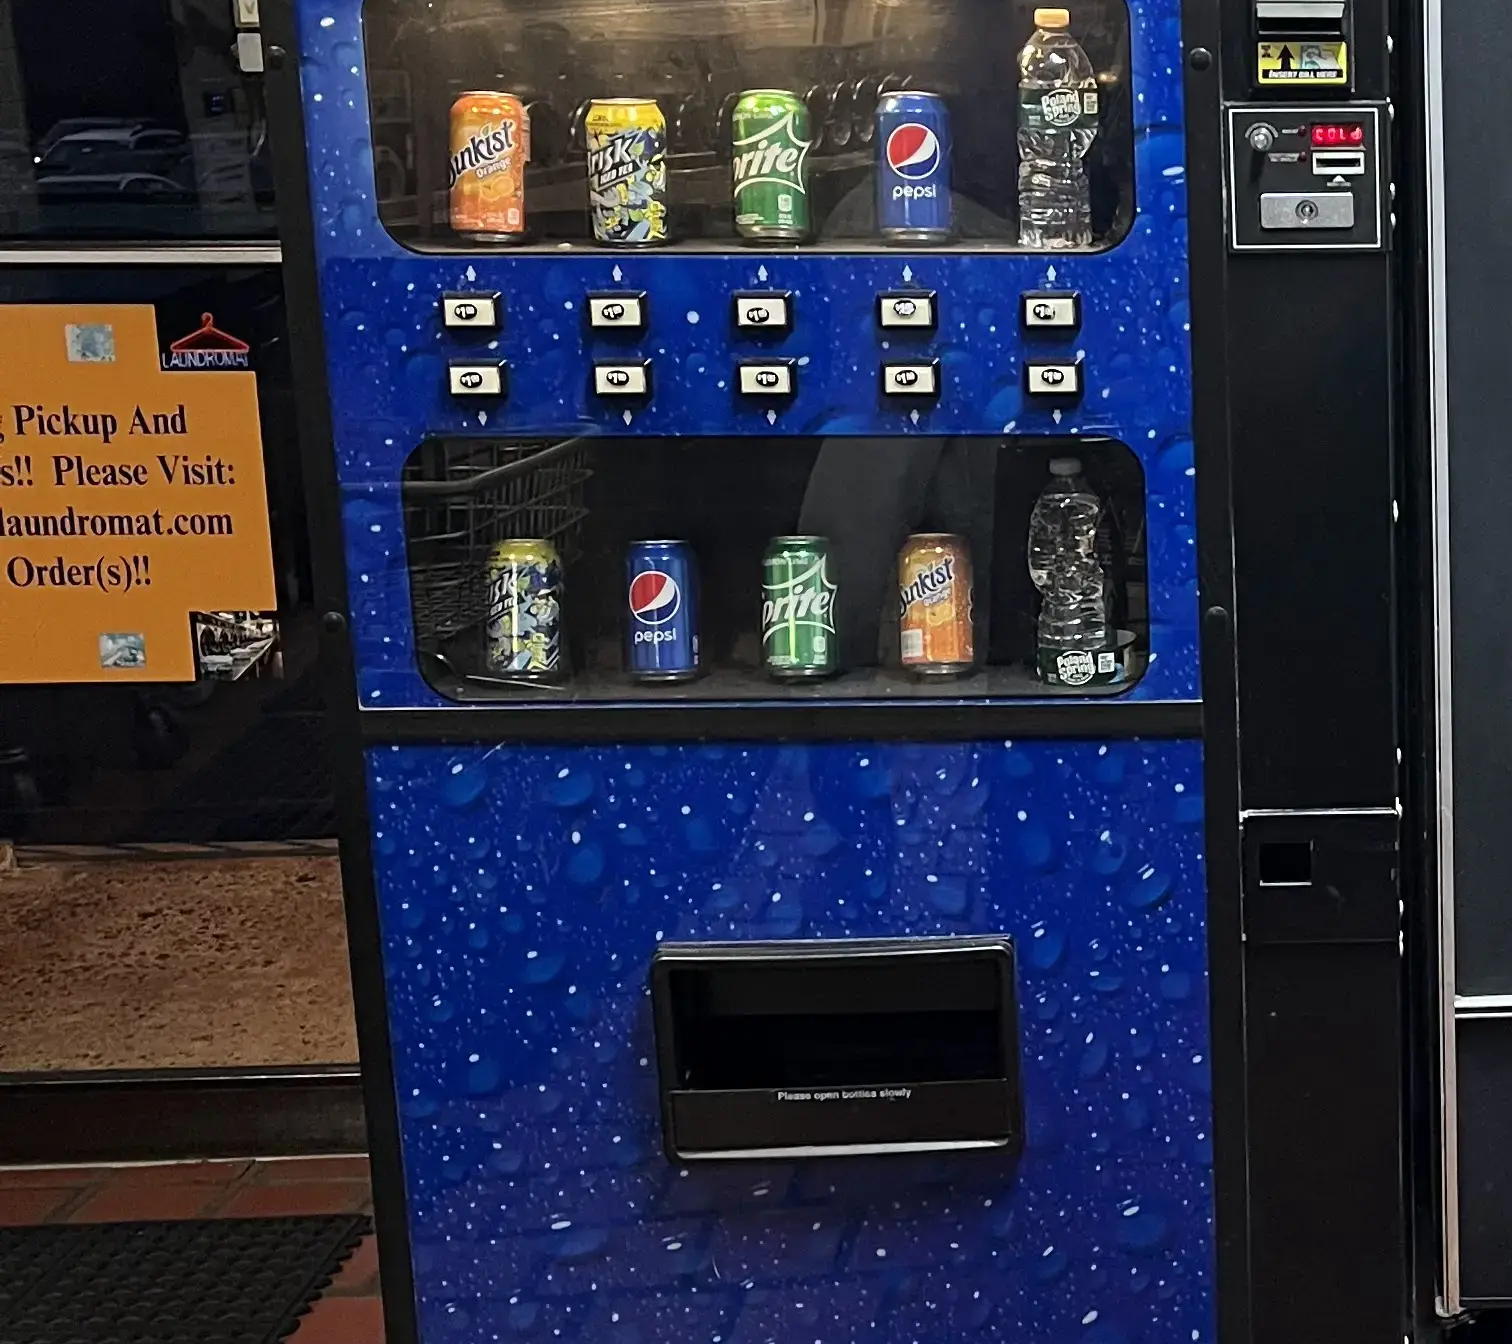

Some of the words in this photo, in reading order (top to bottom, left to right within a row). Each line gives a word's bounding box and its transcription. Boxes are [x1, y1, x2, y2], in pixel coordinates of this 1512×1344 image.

[1041, 90, 1079, 109] Poland
[1044, 101, 1081, 122] Spring
[475, 156, 512, 179] Orange
[892, 184, 937, 201] pepsi
[162, 352, 249, 369] LAUNDROMAT
[11, 404, 118, 444] Pickup
[128, 404, 189, 435] And
[51, 455, 149, 486] Please
[156, 455, 236, 486] Visit:
[7, 555, 151, 593] Order(s)!!
[762, 584, 830, 632] prite
[634, 628, 677, 644] pepsi
[1056, 652, 1094, 669] Poland
[778, 1091, 812, 1101] Please
[814, 1090, 840, 1102] open
[842, 1089, 877, 1099] bottles
[880, 1088, 912, 1099] slowly
